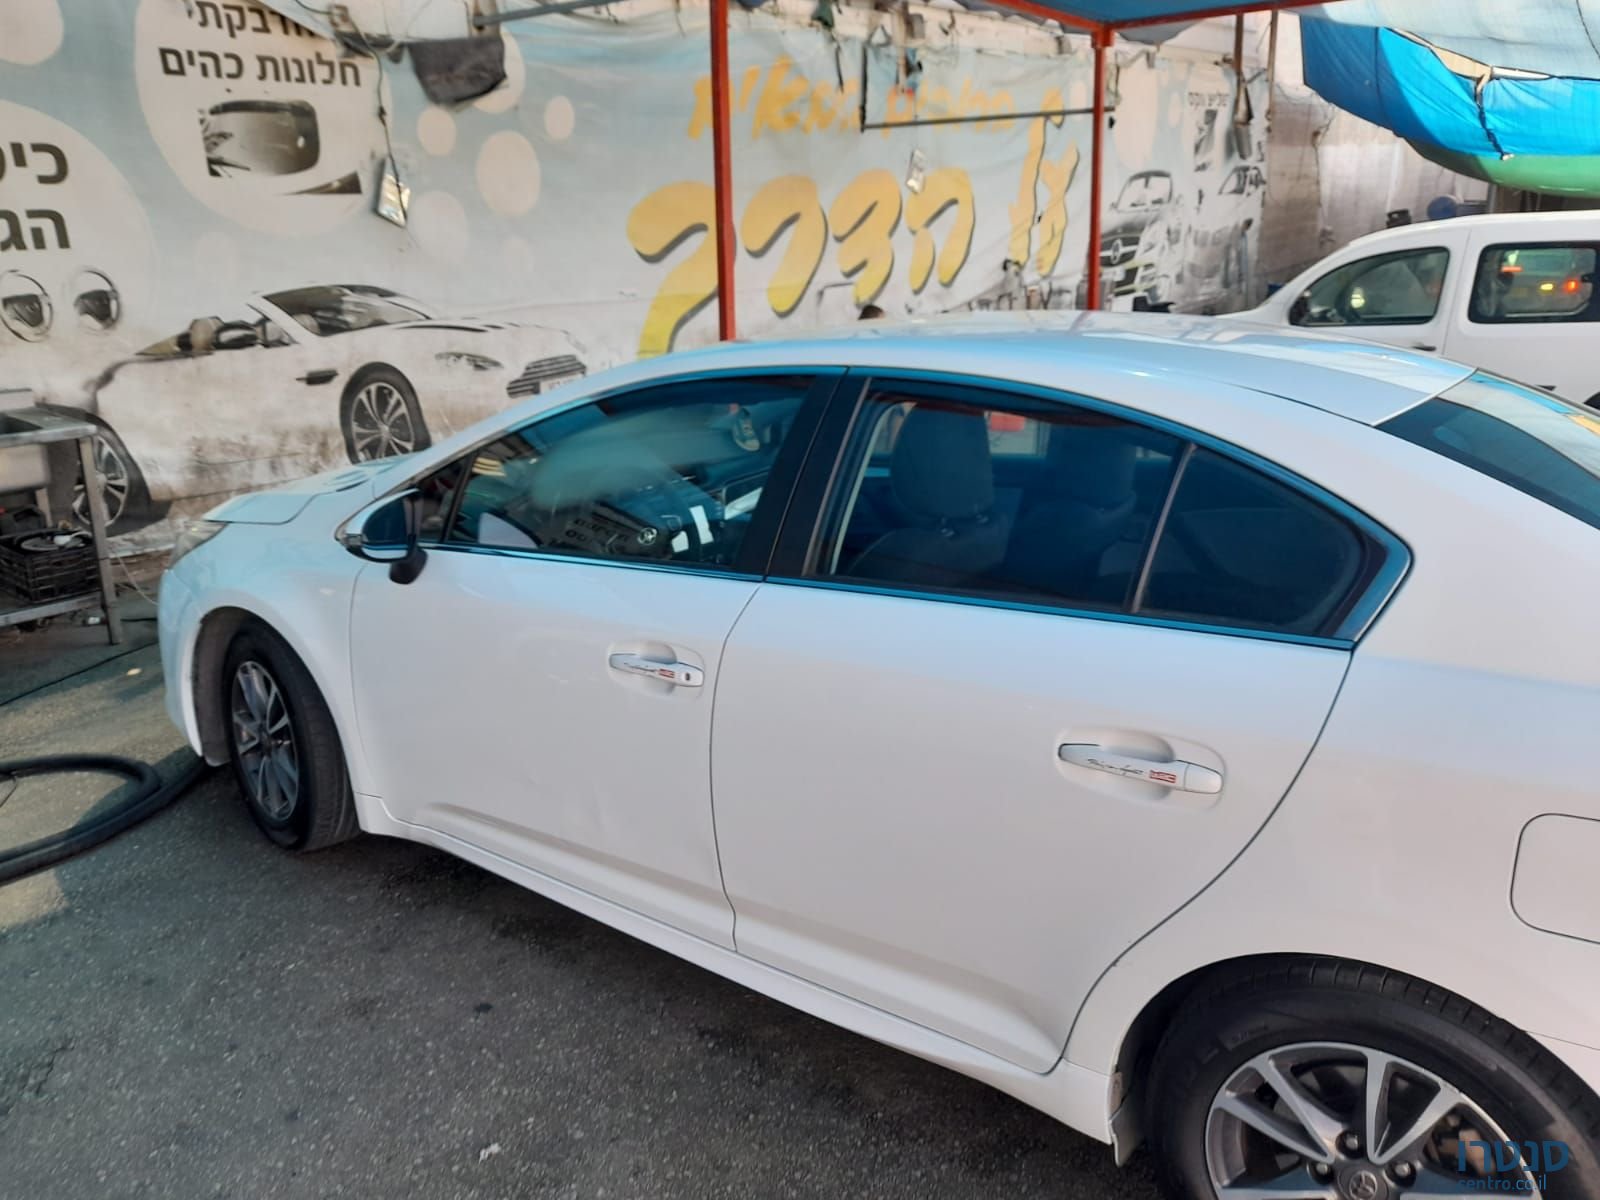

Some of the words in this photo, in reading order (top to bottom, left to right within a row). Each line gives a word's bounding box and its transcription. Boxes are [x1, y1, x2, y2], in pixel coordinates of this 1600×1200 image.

[158, 47, 244, 79] כהים
[256, 51, 361, 87] חלונות
[0, 142, 69, 184] כי
[626, 167, 976, 360] הדרך
